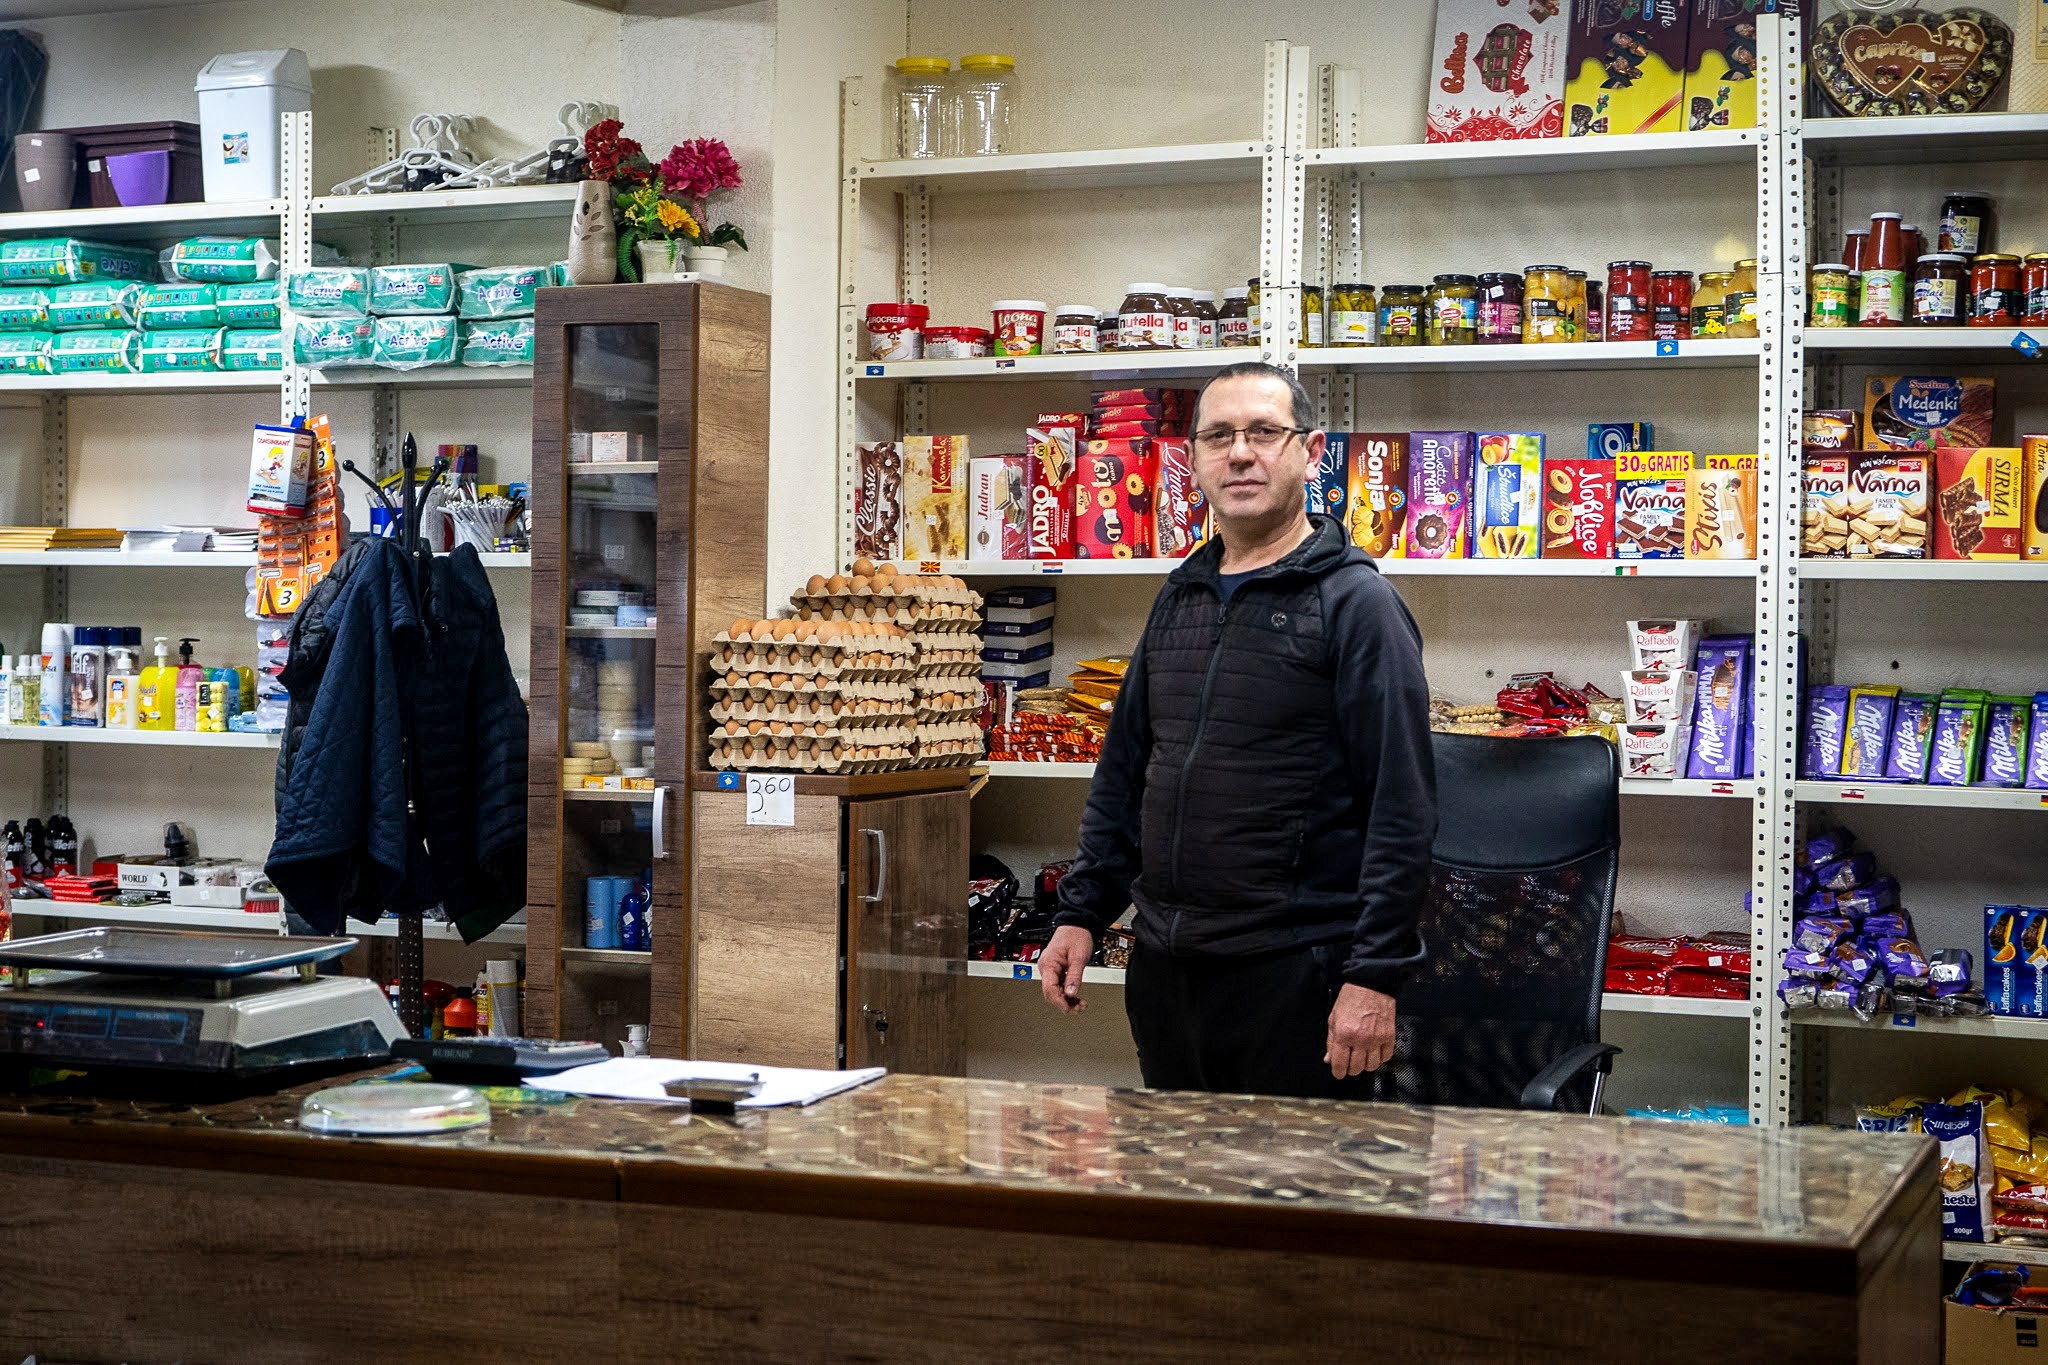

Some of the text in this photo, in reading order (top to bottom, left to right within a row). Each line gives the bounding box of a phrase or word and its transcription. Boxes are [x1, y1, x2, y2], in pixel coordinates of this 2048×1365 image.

[1511, 39, 1531, 81] Chocolate
[386, 281, 425, 295] Active
[1119, 315, 1164, 329] nutella
[1220, 322, 1247, 333] nute
[1038, 414, 1061, 424] JADRO
[1808, 435, 1841, 448] Varna
[318, 450, 325, 468] 3
[931, 438, 950, 490] Karmela
[1648, 455, 1690, 472] GRATIS
[1737, 458, 1758, 470] GRA
[1365, 440, 1389, 506] Sonja
[1853, 470, 1921, 494] Varna
[978, 473, 989, 521] Jadran
[1497, 466, 1517, 525] Štrudlice
[1621, 487, 1685, 511] Varna
[1993, 458, 2011, 517] SIRMA
[856, 464, 877, 536] Classic
[1578, 467, 1604, 553] Noblice
[1030, 485, 1057, 557] JADRO
[281, 579, 297, 587] BIC
[281, 590, 292, 606] 3
[1636, 635, 1680, 646] Raffaello
[1697, 707, 1724, 765] Milka
[1811, 706, 1841, 767] Milka
[1857, 704, 1884, 761] Milka
[1896, 719, 1920, 773] Milka
[1937, 728, 1966, 781] Milka
[1990, 725, 2016, 778] Milka
[121, 874, 147, 884] WORLD
[1942, 1194, 1976, 1206] heste
[1953, 1227, 1974, 1235] 800gr
